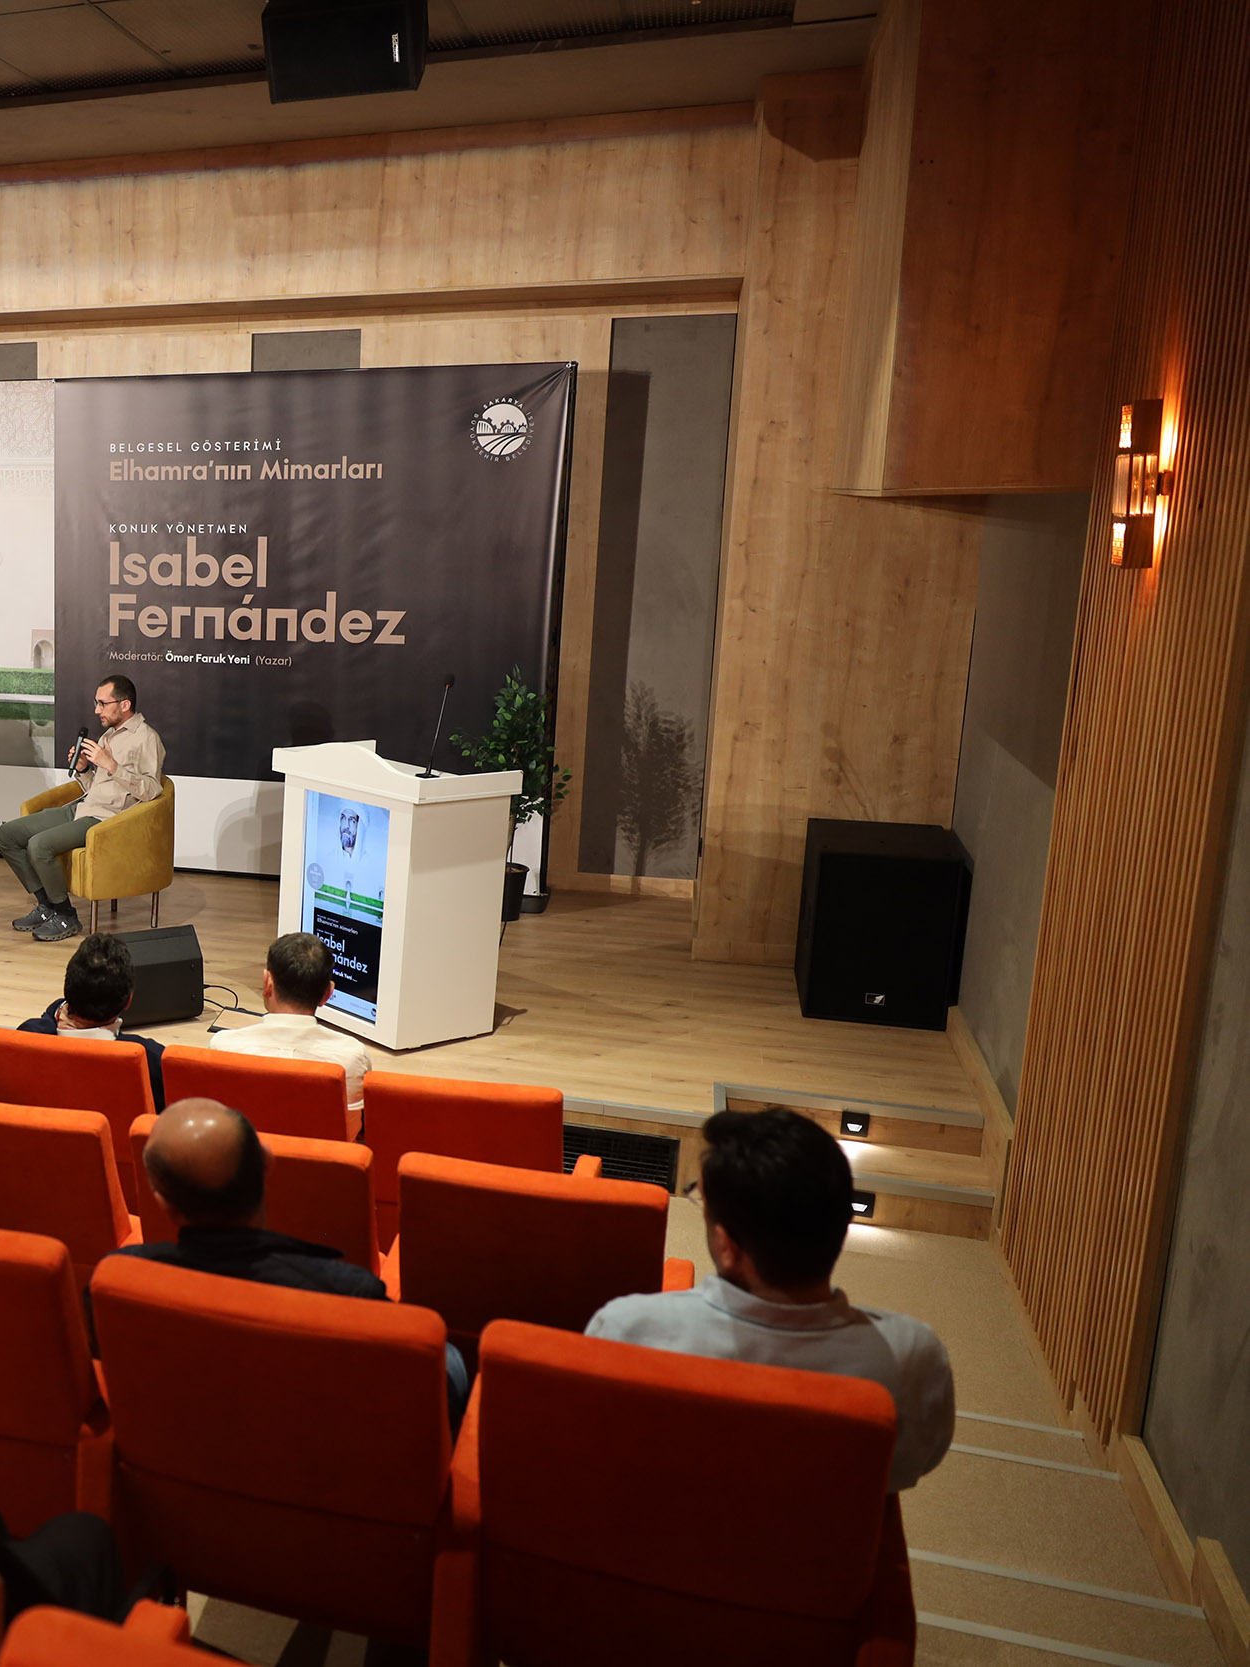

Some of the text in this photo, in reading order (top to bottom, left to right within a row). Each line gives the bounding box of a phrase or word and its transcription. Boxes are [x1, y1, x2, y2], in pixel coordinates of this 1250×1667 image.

[483, 397, 523, 409] SAKARYA
[109, 438, 282, 453] BELGESEL GÖSTERİMİ
[260, 455, 383, 480] Mimarları
[109, 521, 248, 534] KONUK YÖNETMEN
[109, 536, 268, 588] Isabel
[109, 591, 407, 645] Fernández
[109, 650, 292, 667] Moderatör: Ömer Faruk Yeni (Yazar)
